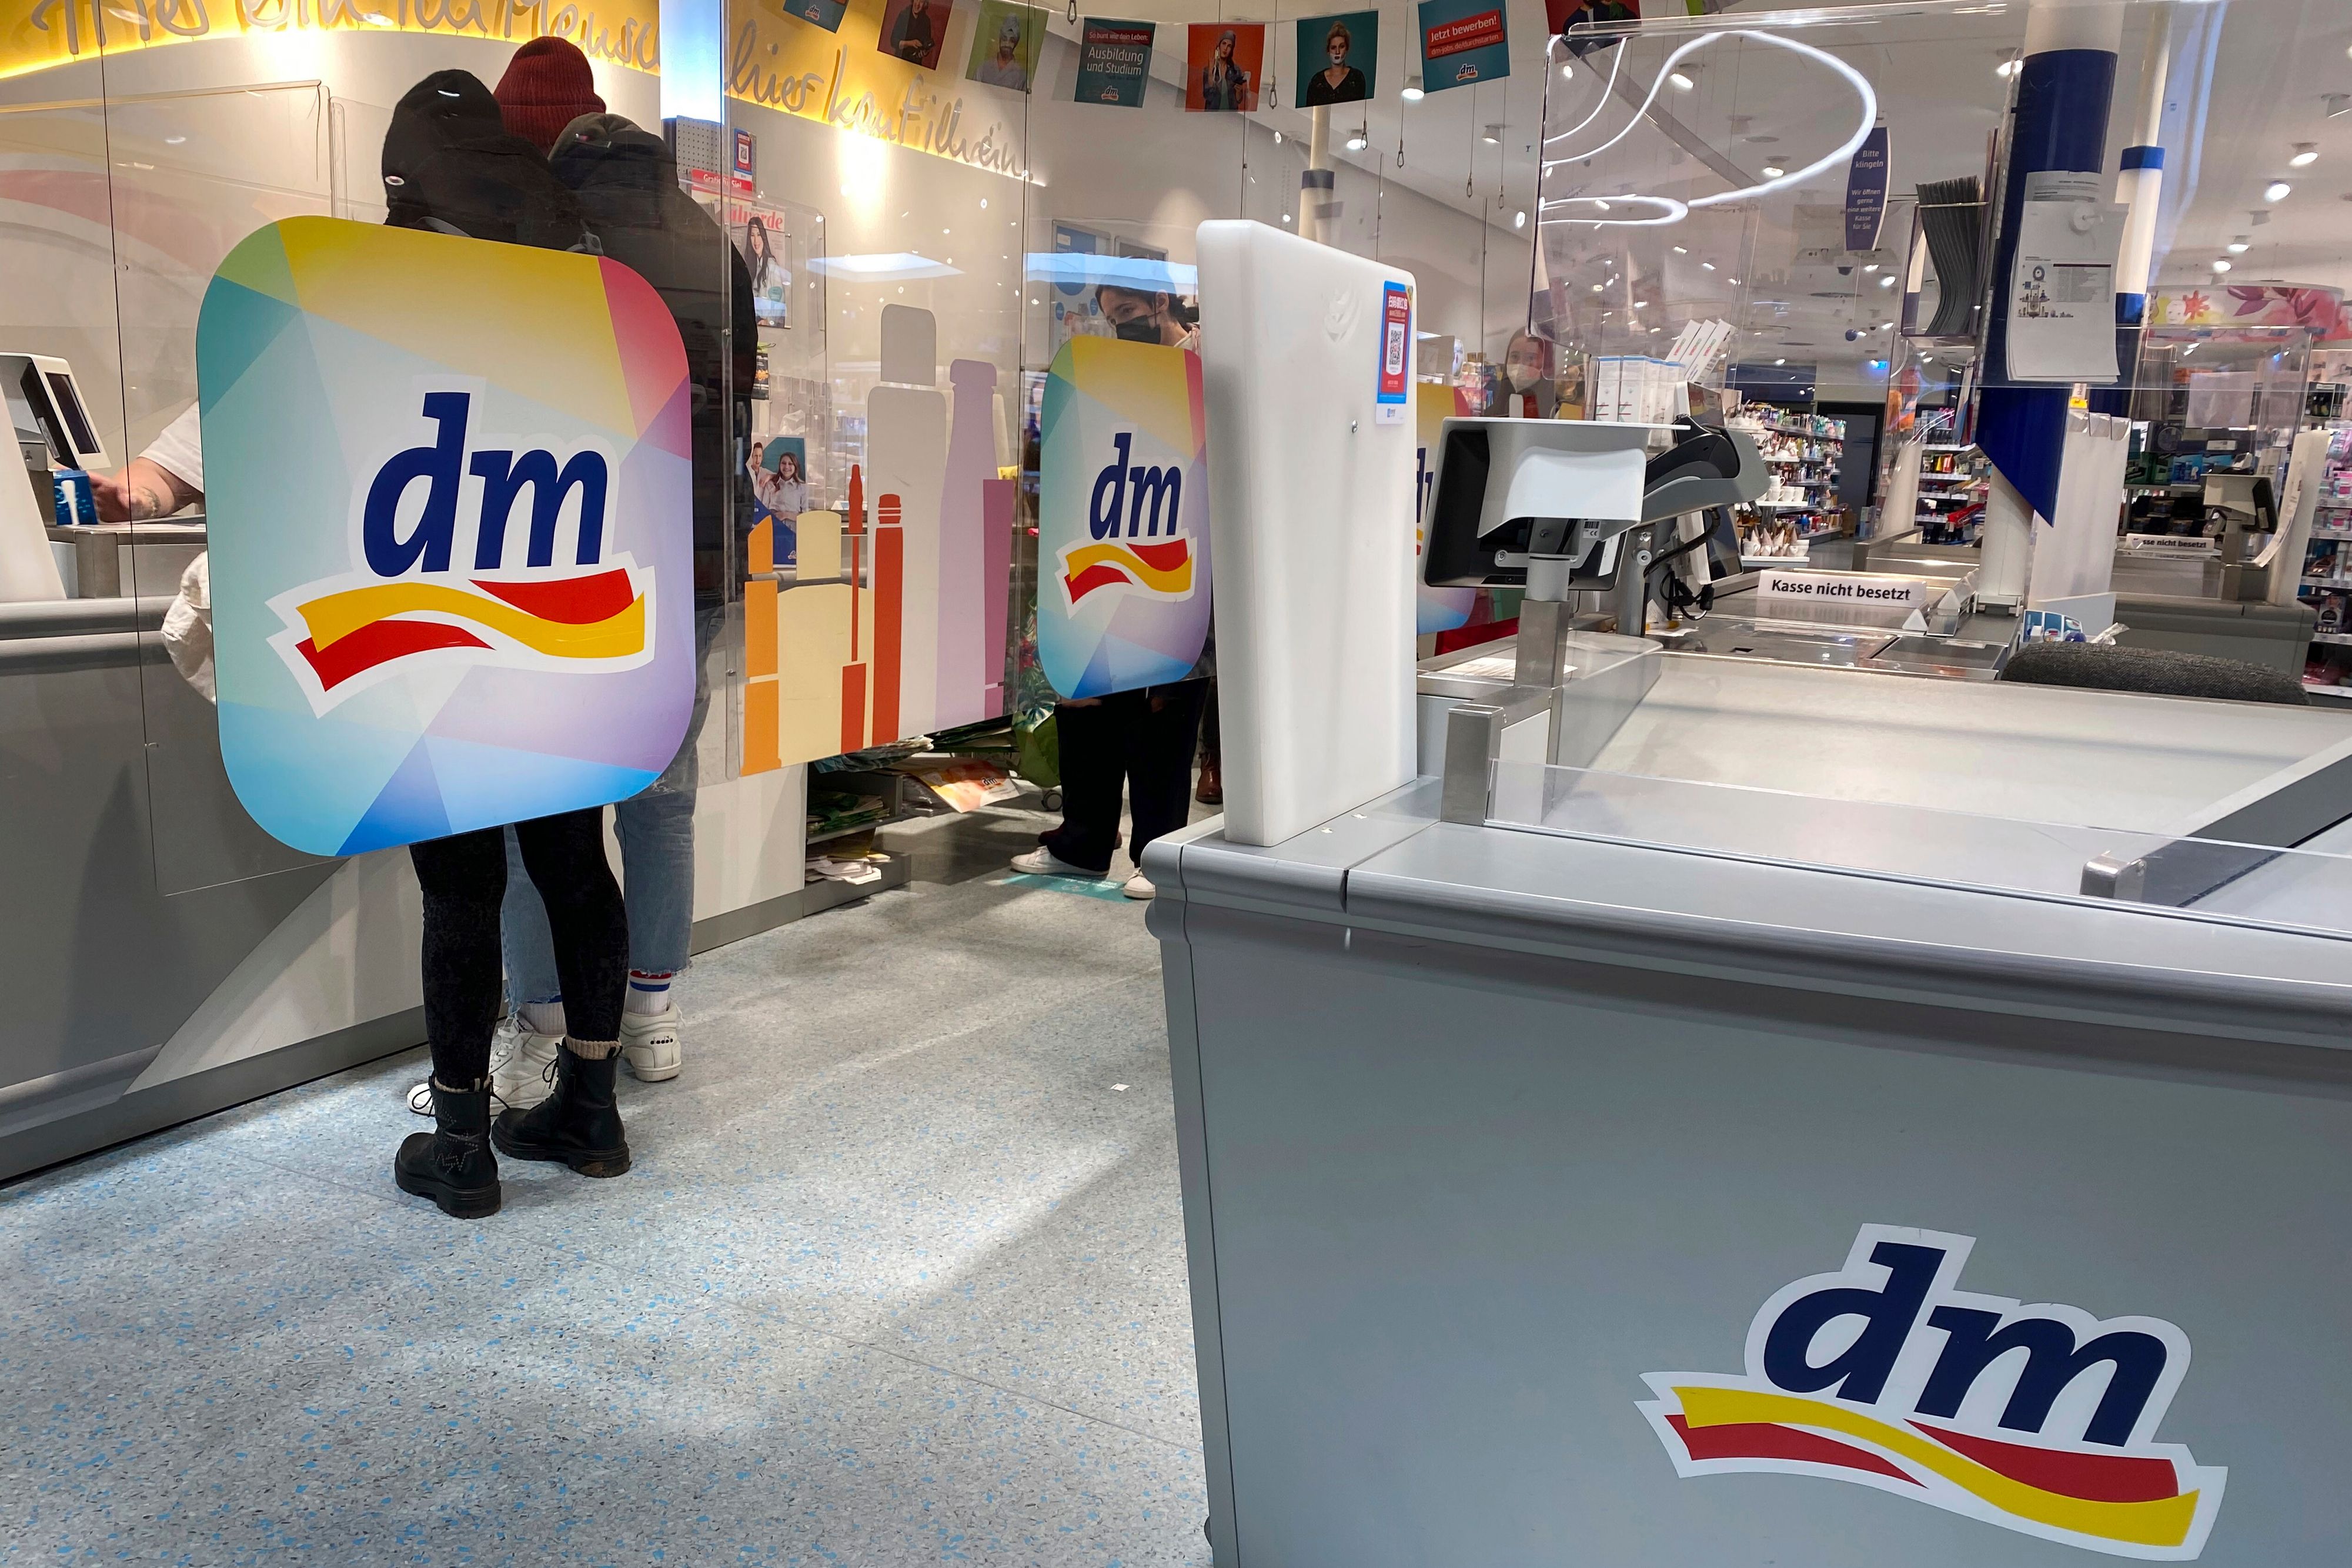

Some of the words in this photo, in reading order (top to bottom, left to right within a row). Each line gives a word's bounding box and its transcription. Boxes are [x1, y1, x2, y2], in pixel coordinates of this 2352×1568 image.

[1431, 28, 1451, 42] Jetzt
[1452, 15, 1497, 36] bewerben!
[1088, 46, 1144, 65] Ausbildung
[1431, 34, 1499, 56] dm-jobs.de/durchstarten
[1087, 62, 1103, 72] und
[1105, 62, 1142, 75] Studium
[1855, 160, 1883, 169] klingeln
[363, 392, 608, 577] dm
[1089, 432, 1182, 540] dm
[1772, 579, 1812, 594] Kasse
[1816, 583, 1853, 596] nicht
[1856, 585, 1911, 600] besetzt
[1764, 1241, 2167, 1447] dm
